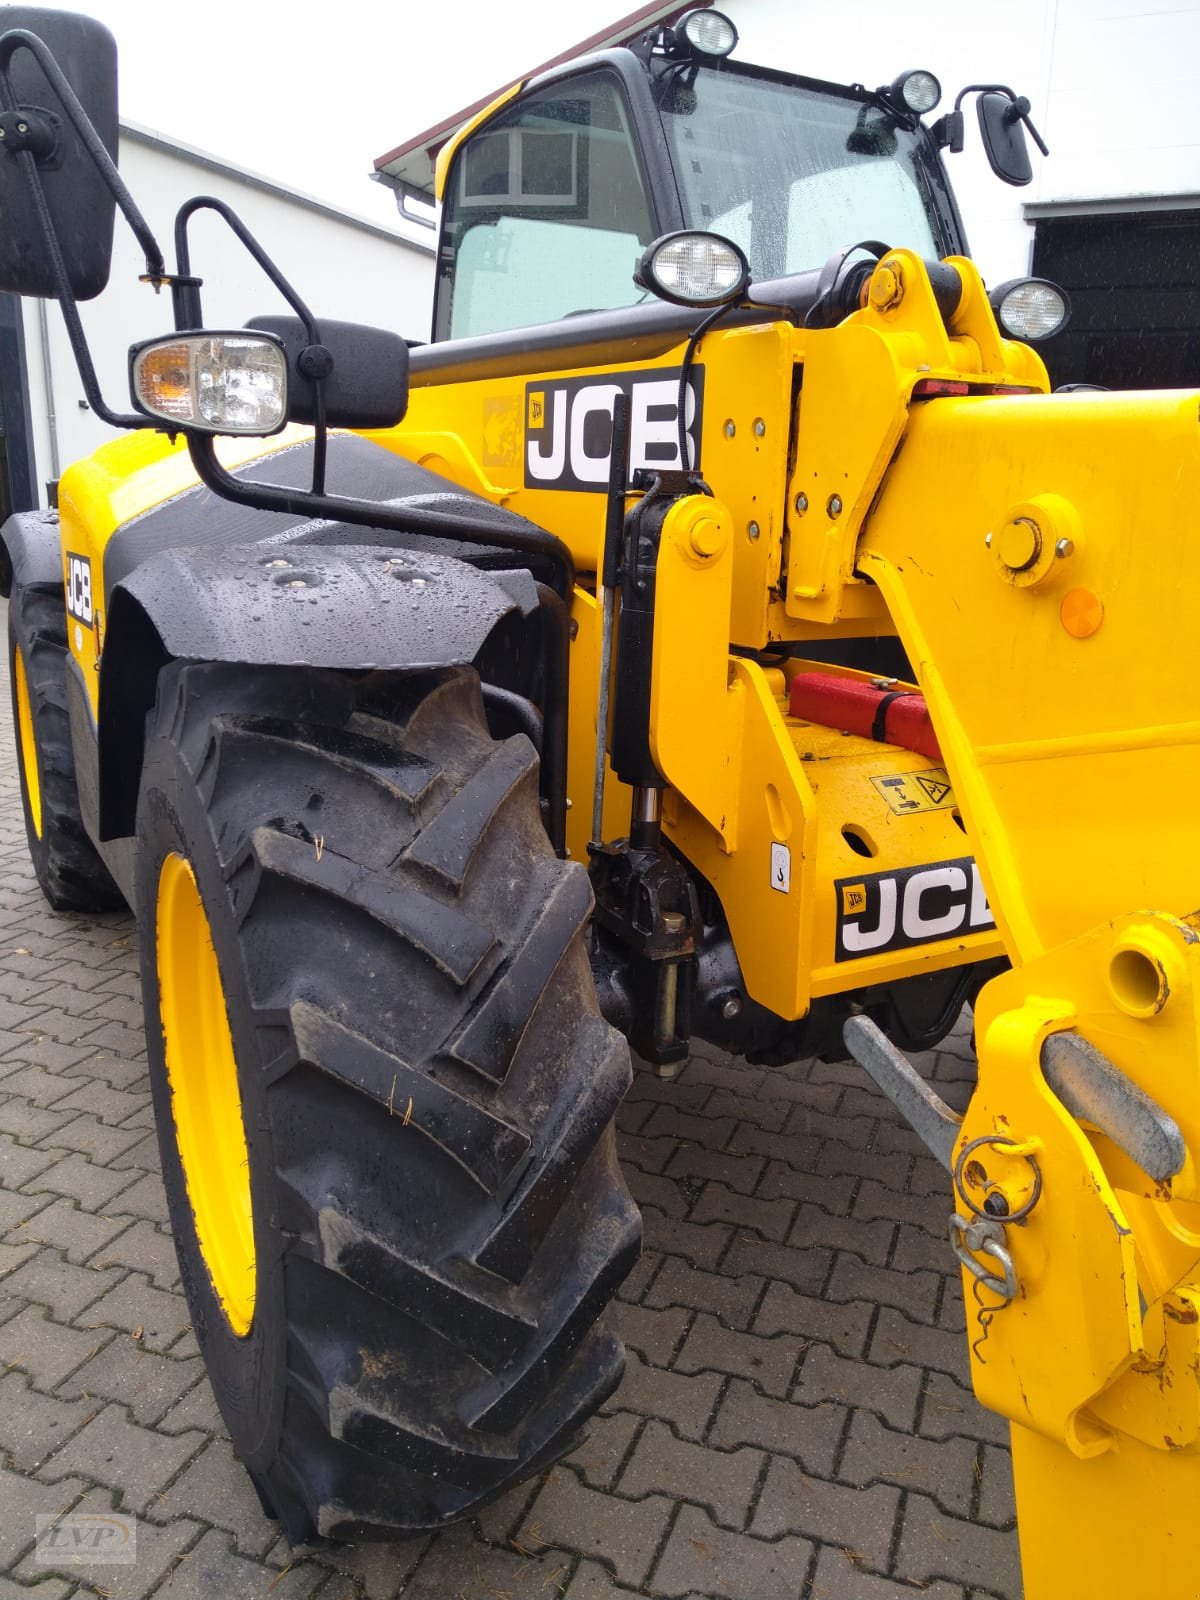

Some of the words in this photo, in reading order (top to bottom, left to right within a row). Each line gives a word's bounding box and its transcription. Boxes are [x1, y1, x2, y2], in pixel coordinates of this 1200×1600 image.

[528, 380, 695, 483] JCB
[67, 558, 92, 622] JCB
[849, 893, 863, 907] JCB
